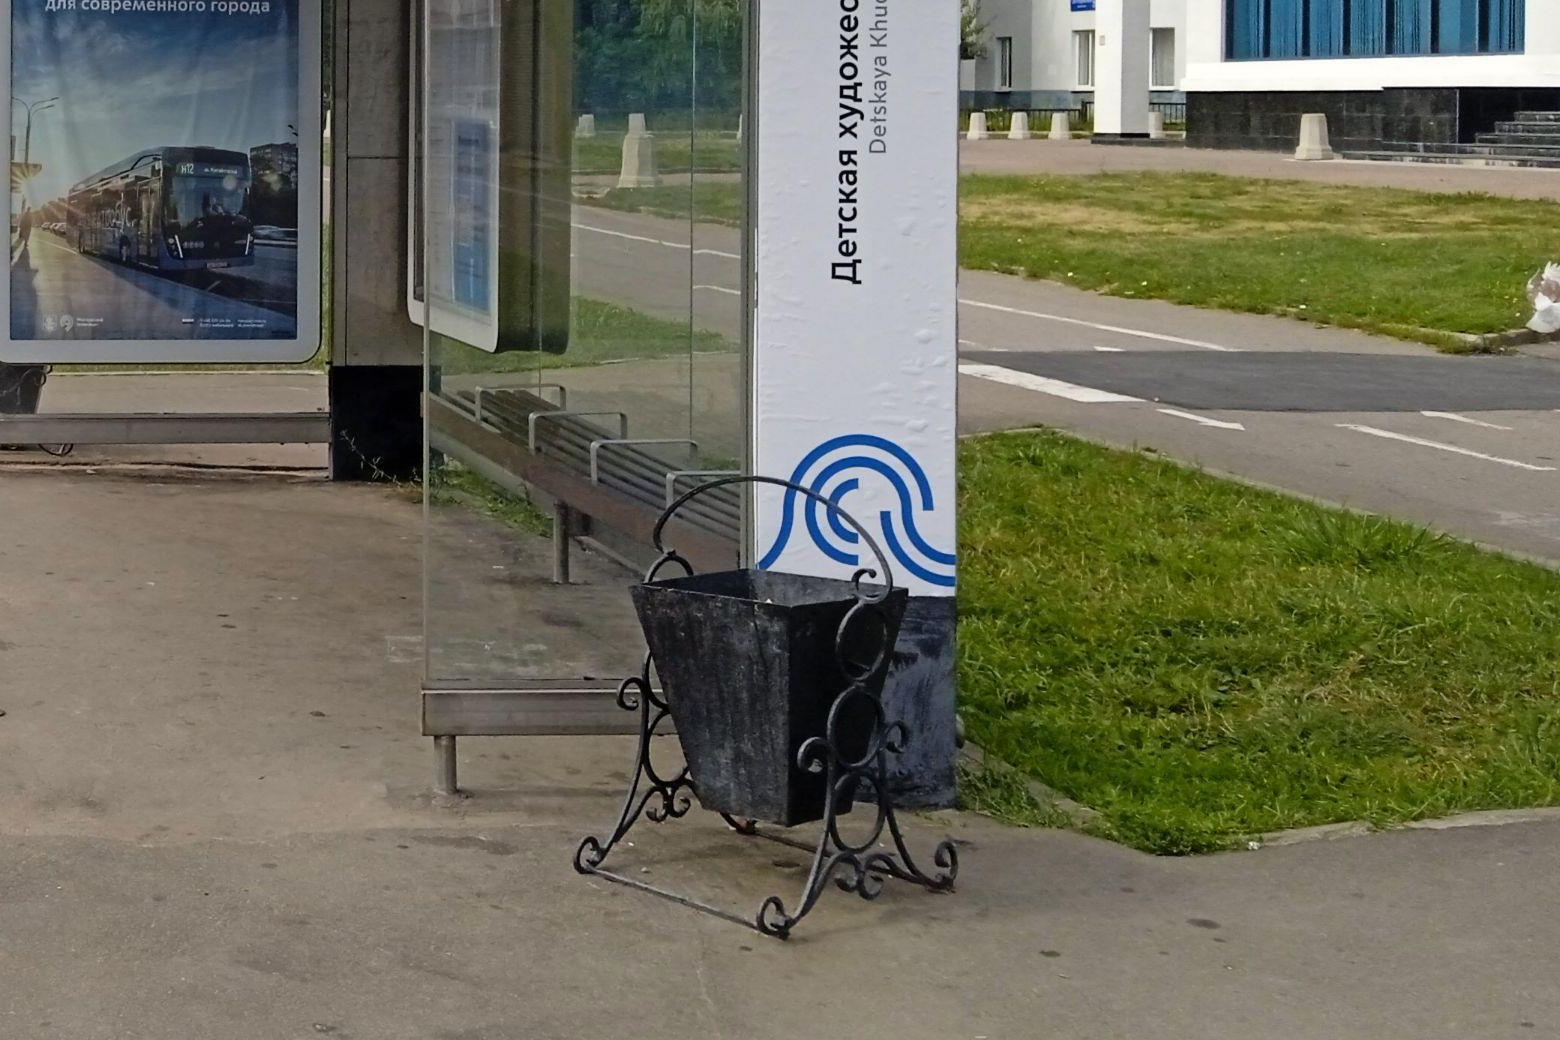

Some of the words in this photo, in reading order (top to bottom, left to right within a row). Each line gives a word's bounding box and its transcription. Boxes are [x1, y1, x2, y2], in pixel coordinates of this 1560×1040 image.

[210, 1, 270, 16] города
[868, 55, 892, 154] Detskaya
[831, 149, 863, 285] Детская
